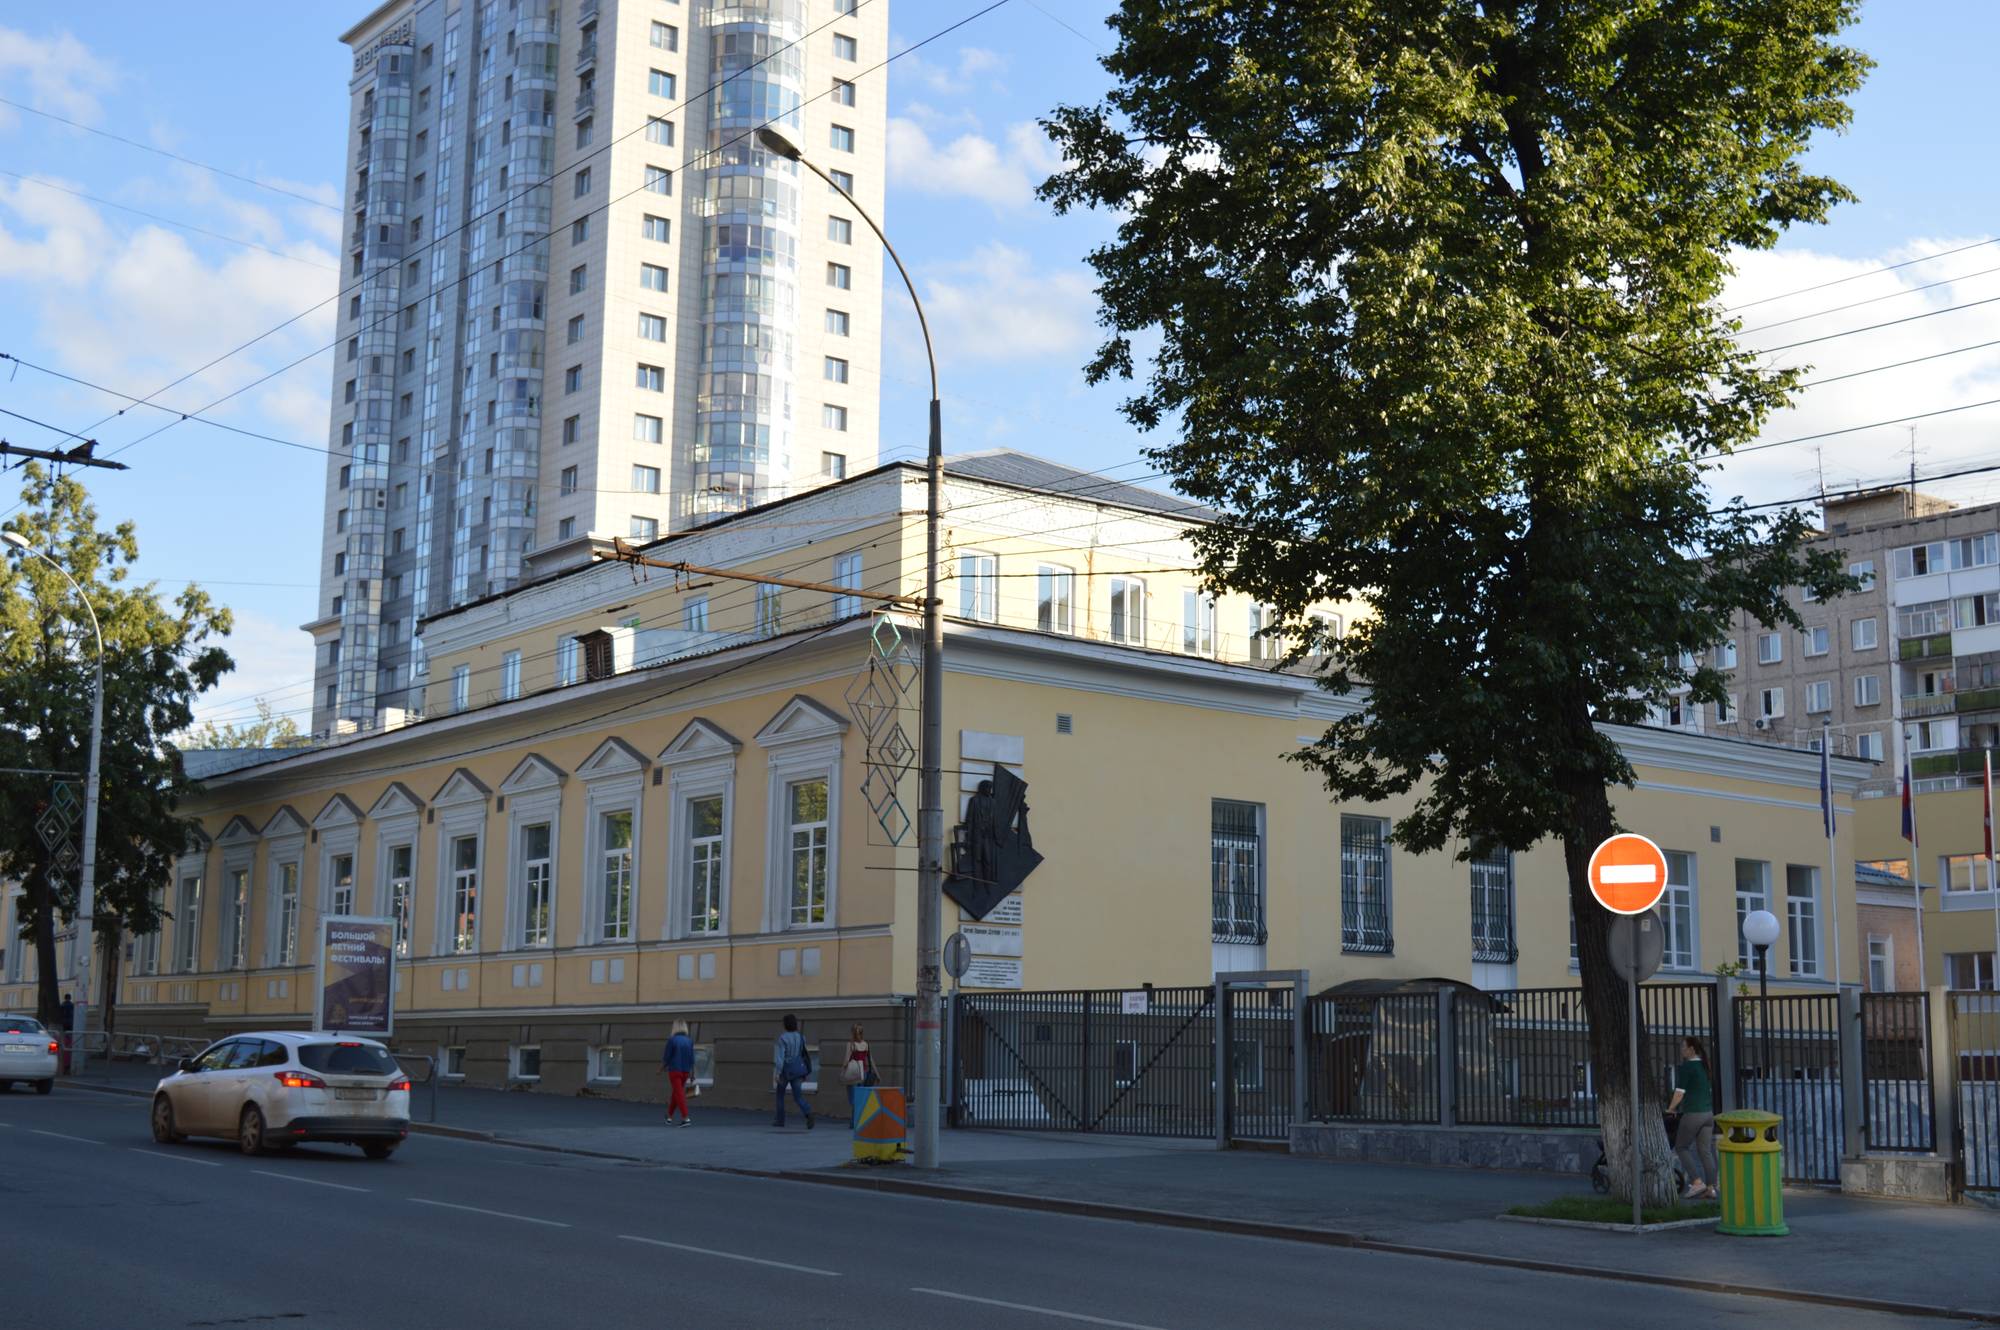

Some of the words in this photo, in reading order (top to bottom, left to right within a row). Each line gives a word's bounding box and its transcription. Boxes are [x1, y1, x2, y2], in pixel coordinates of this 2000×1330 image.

[331, 931, 376, 942] БОЛЬШОЙ
[331, 942, 366, 952] ЛЕТНИЙ
[331, 954, 385, 964] ФЕСТИВАЛЬ!
